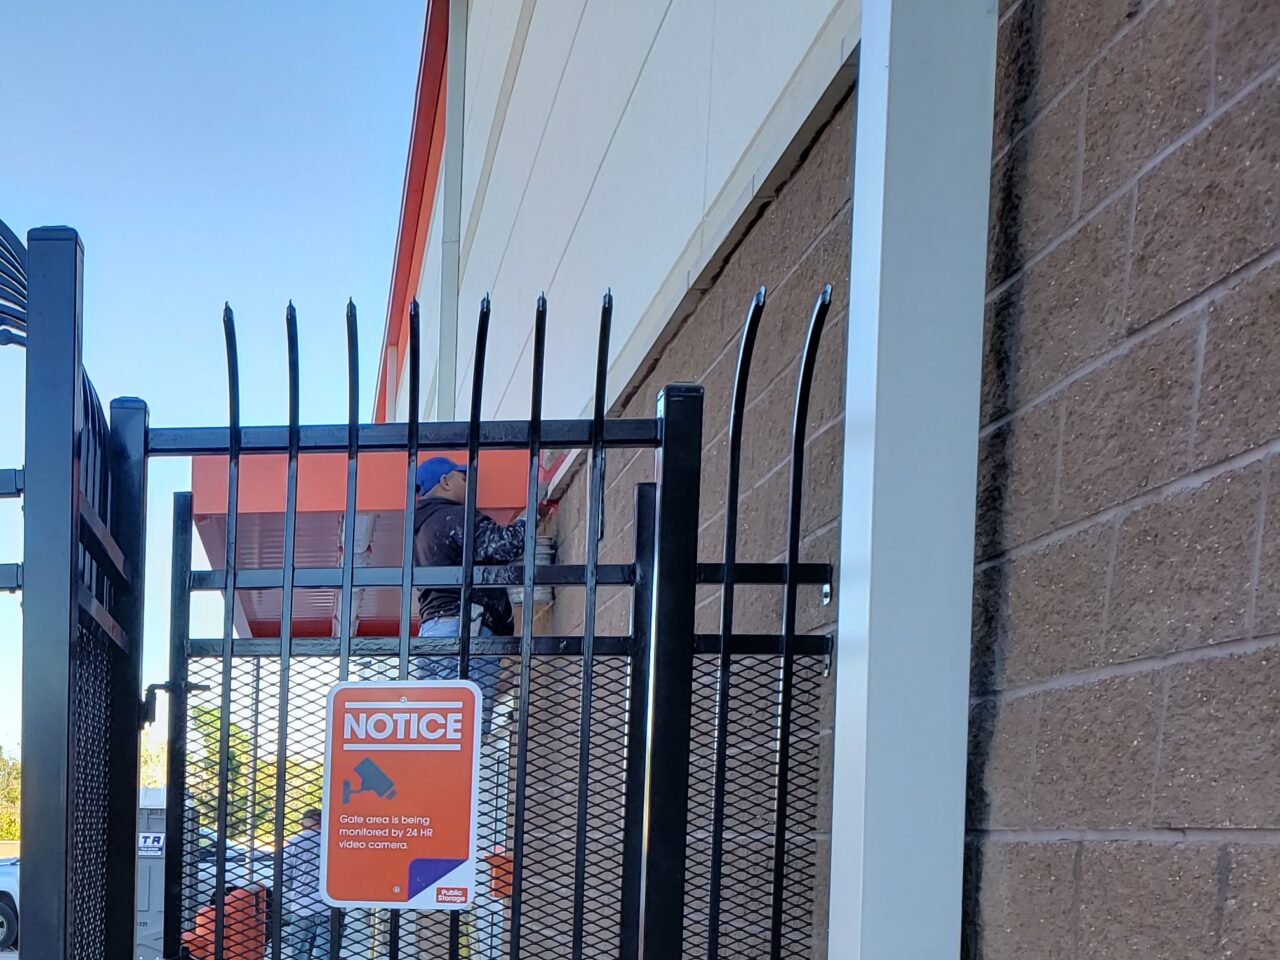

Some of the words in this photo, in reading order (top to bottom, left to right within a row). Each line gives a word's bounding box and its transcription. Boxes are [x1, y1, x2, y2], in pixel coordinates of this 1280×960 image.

[343, 712, 463, 740] NOTICE
[339, 814, 364, 824] Gate
[366, 816, 389, 824] area
[391, 815, 399, 824] is
[401, 815, 430, 827] being
[339, 828, 389, 837] monitored
[391, 828, 404, 838] by
[406, 828, 418, 837] 24
[420, 828, 433, 838] HR
[339, 840, 366, 849] video
[368, 841, 409, 850] camera.
[438, 895, 466, 903] Storage
